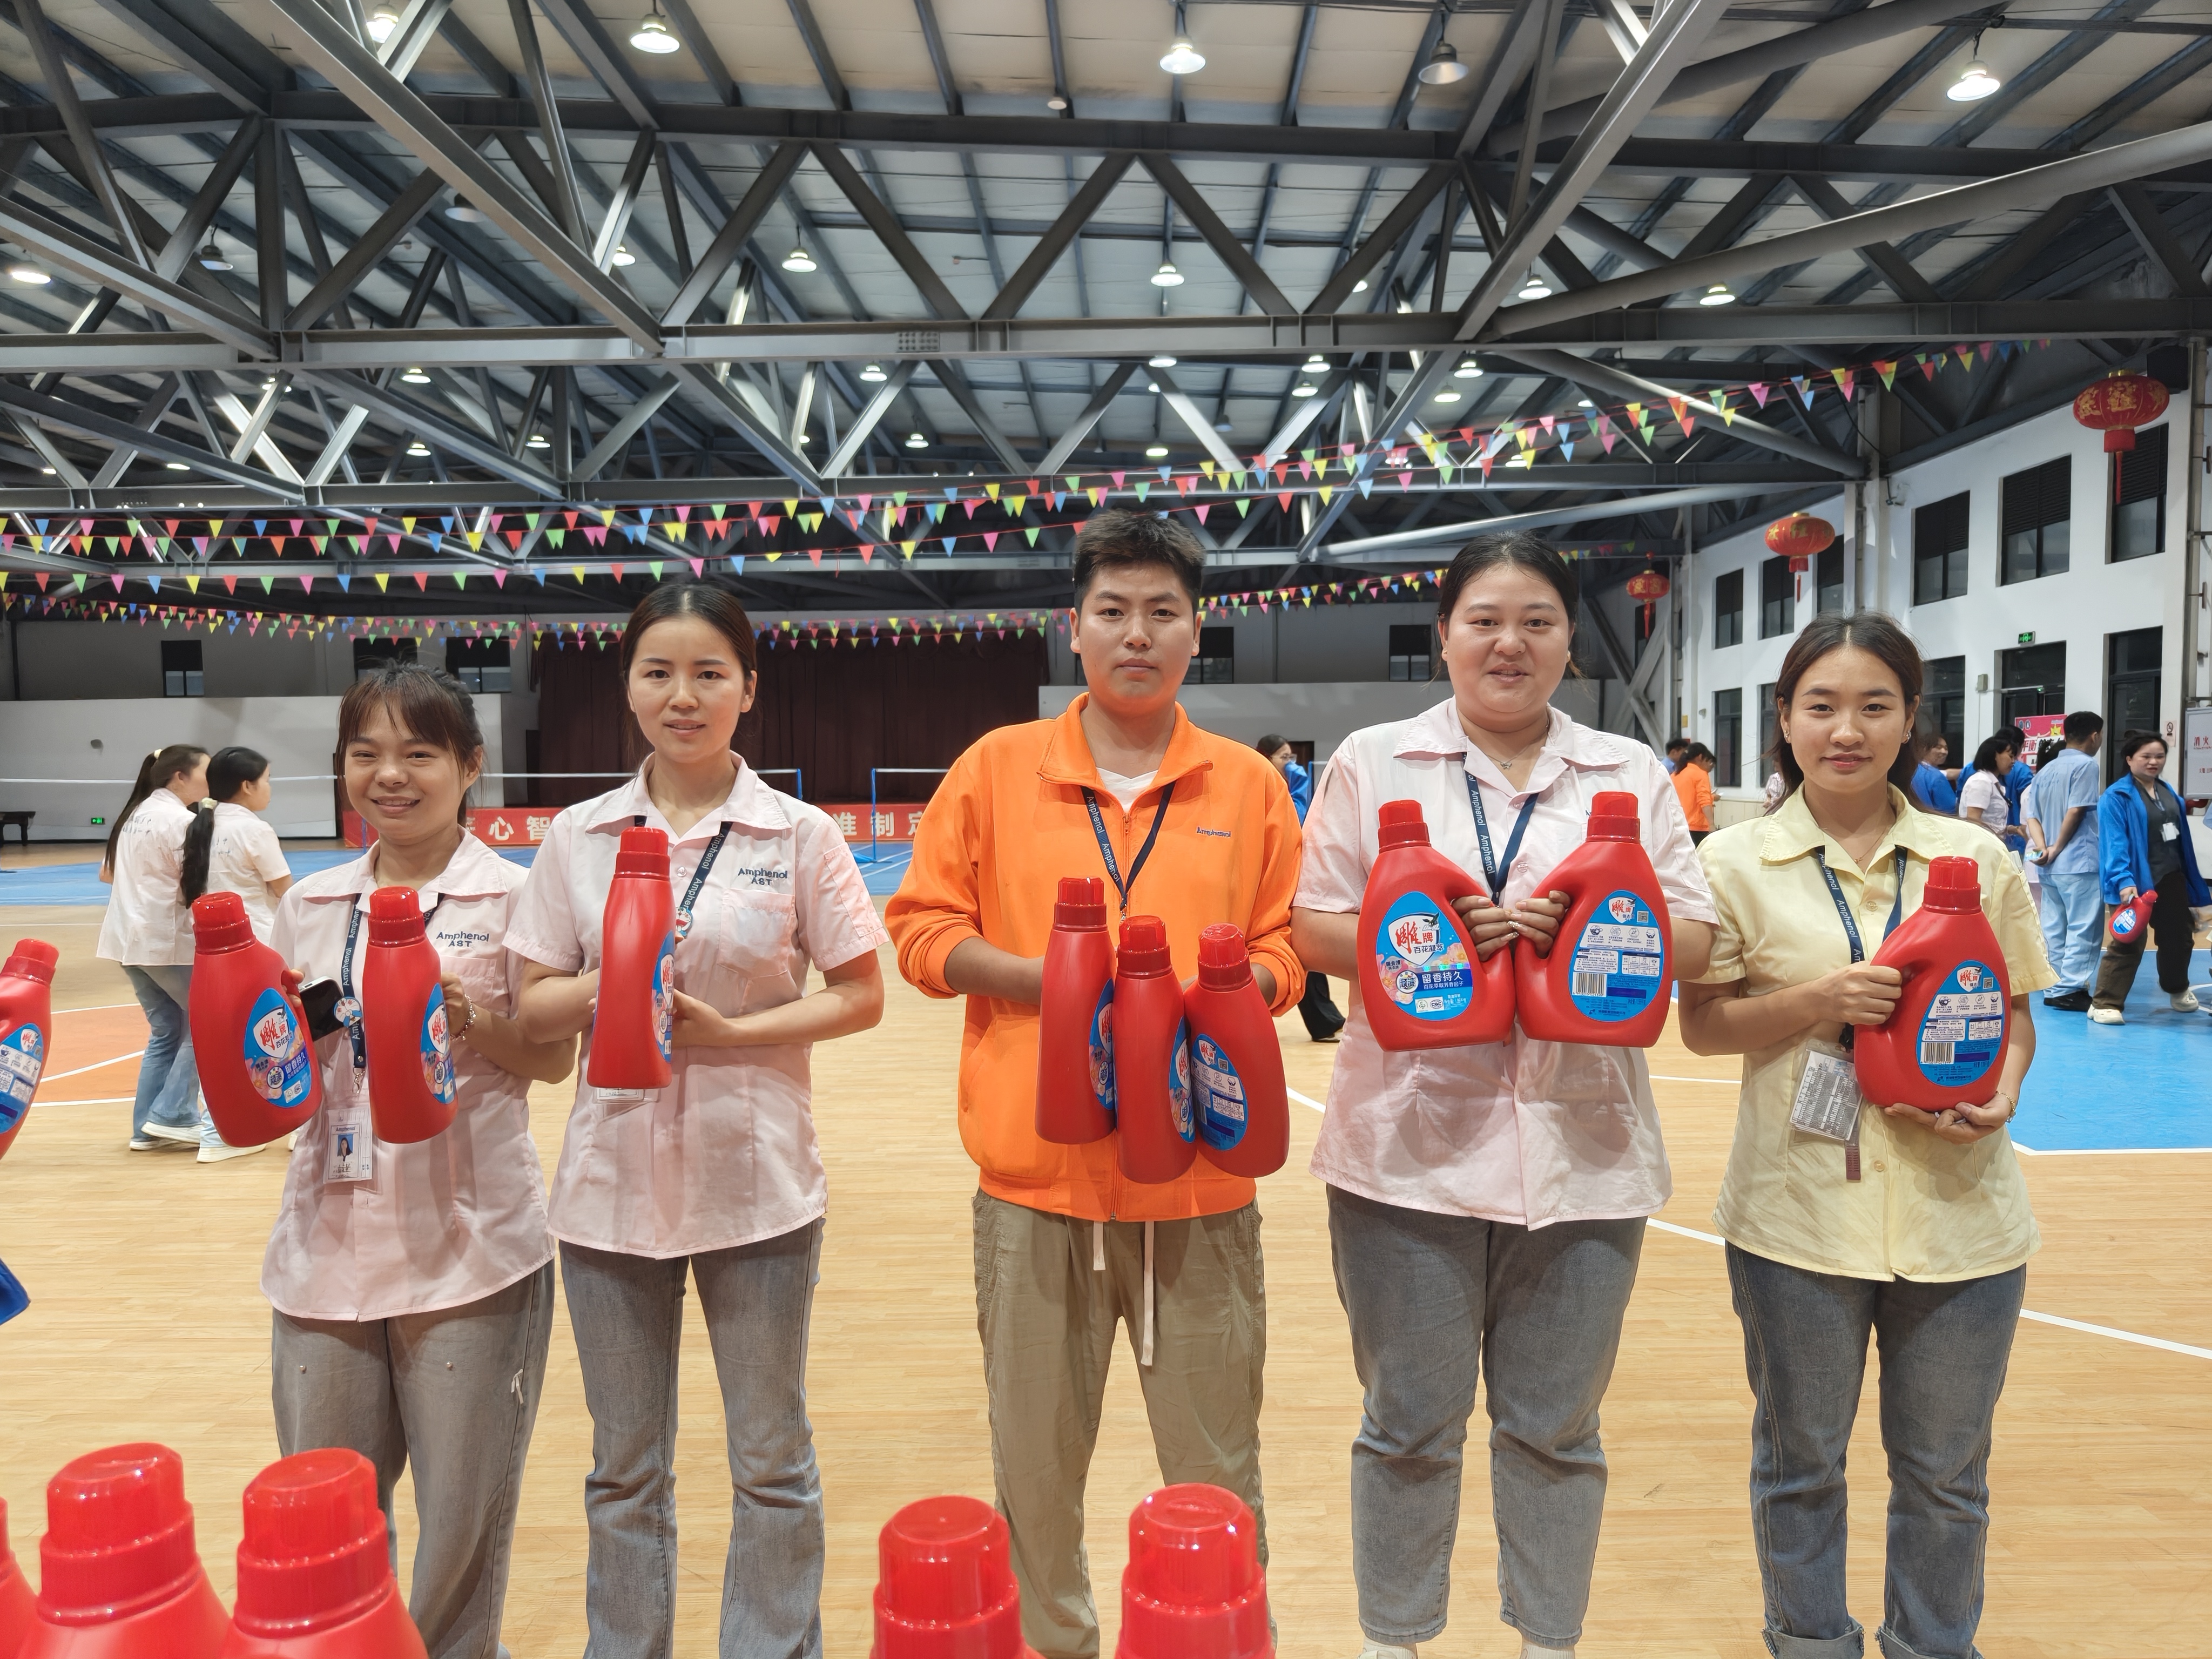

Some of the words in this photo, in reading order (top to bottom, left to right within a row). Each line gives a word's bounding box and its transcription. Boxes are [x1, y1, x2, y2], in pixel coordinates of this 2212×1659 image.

[1087, 796, 1105, 834] Amphenol
[1471, 790, 1486, 826] Amphenol
[702, 833, 725, 869] Amphenol
[1102, 843, 1120, 882] Amphenol
[1480, 834, 1496, 874] Amphenol
[738, 867, 788, 879] Amphenol
[751, 878, 772, 886] AST
[348, 907, 360, 938] Amphen
[1837, 899, 1858, 938] Amphenol
[436, 931, 490, 942] Amphenol
[1395, 921, 1434, 954] 雕牌
[1413, 943, 1444, 954] 百花凝萃
[343, 947, 353, 986] Amphenol
[1422, 972, 1463, 984] 留香持久
